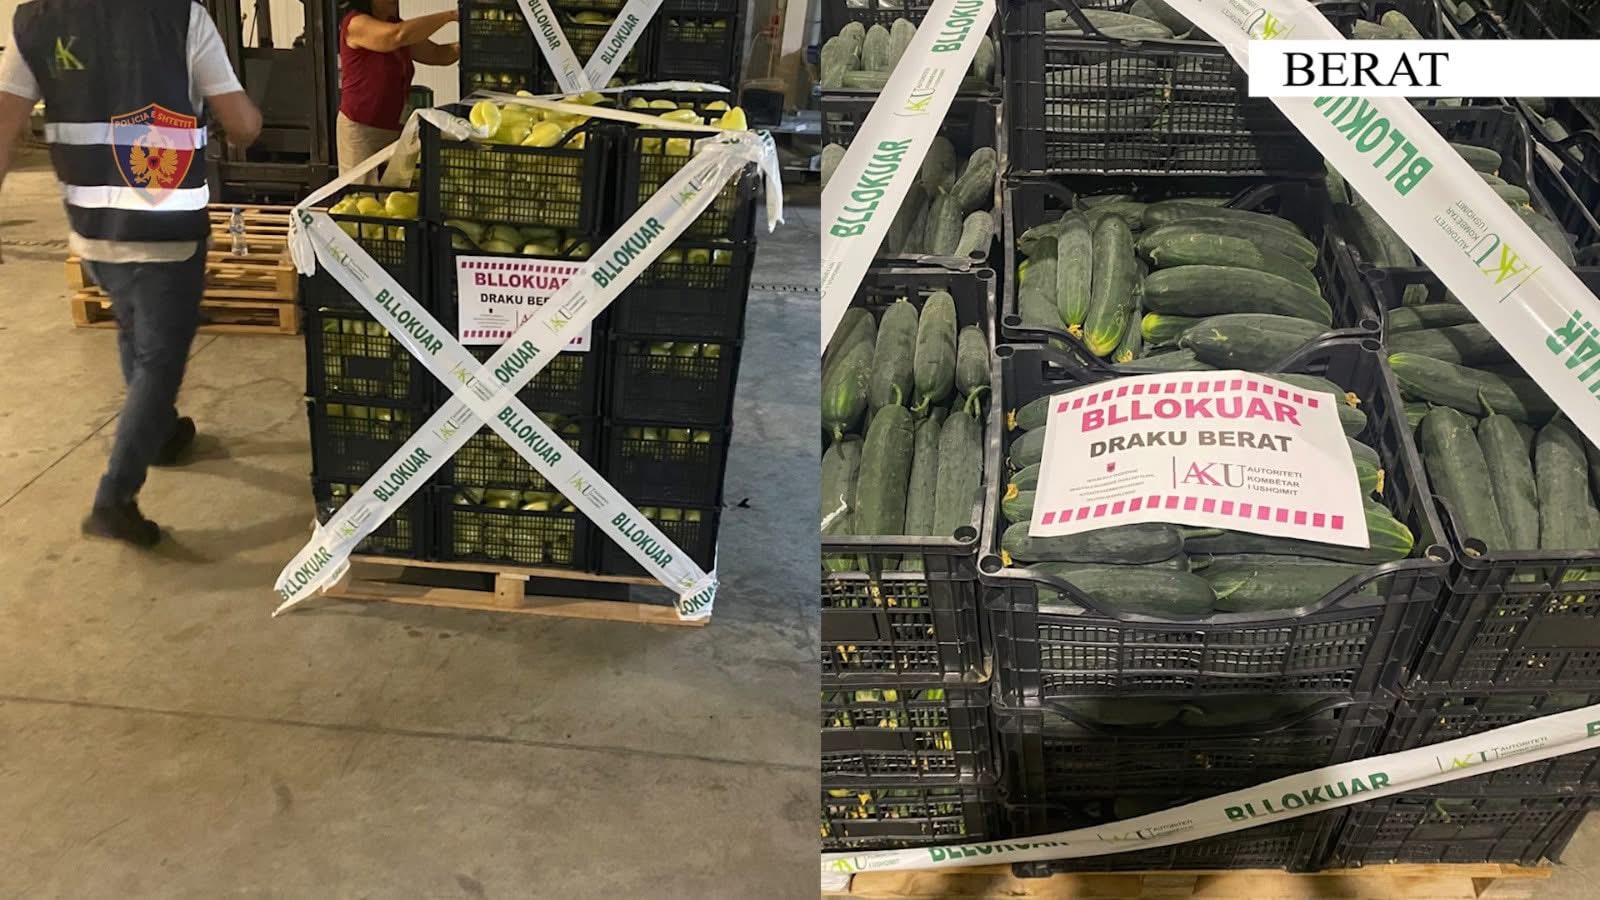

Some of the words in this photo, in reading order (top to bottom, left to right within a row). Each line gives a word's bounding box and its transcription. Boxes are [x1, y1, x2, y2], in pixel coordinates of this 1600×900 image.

[528, 0, 561, 51] BLLOKUAR
[600, 14, 640, 65] BLLOKUAR
[829, 138, 913, 238] BLLOKUAR
[591, 216, 665, 288] BLLOKUAR
[375, 289, 444, 356] BLLOKUAR
[480, 293, 523, 305] DRAKU
[494, 340, 541, 384] OKUAR
[497, 406, 562, 467] BLLOKUAR
[1081, 396, 1302, 432] BLLOKUAR
[1090, 431, 1187, 458] DRAKU
[1198, 430, 1293, 453] BERAT
[373, 447, 432, 502] BLLOKUAR
[1180, 462, 1247, 487] AKU
[1247, 466, 1302, 478] AUTORITETI
[1252, 484, 1298, 496] USHQIMIT
[611, 512, 673, 568] BLLOKUAR
[1224, 771, 1391, 822] BLLOKUAR
